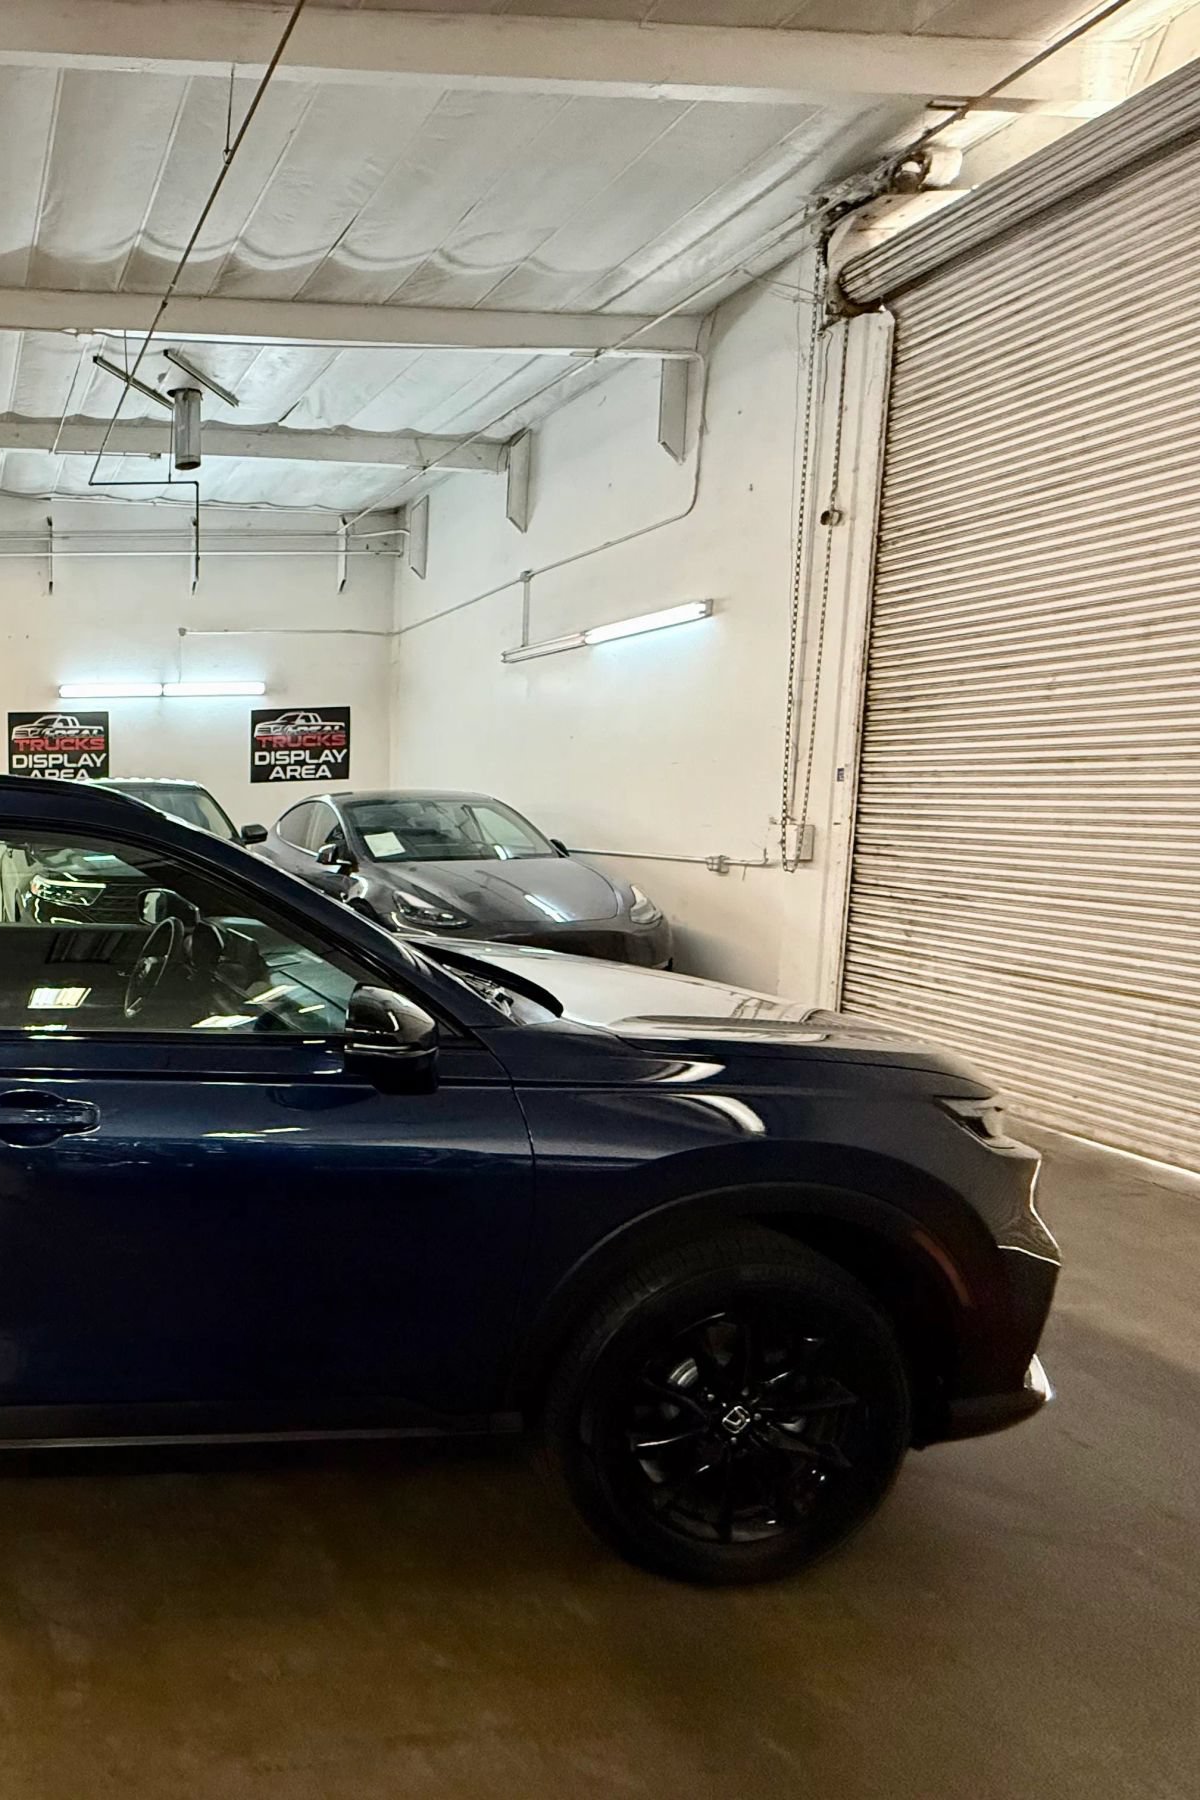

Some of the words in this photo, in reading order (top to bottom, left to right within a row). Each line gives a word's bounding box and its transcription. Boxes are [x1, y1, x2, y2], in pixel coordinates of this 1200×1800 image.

[15, 737, 105, 751] TRUCKS
[256, 733, 345, 748] TRUCKS
[12, 753, 107, 769] DISPLAY
[254, 749, 348, 765] DISPLAY
[30, 768, 90, 780] AREA
[268, 765, 332, 780] AREA
